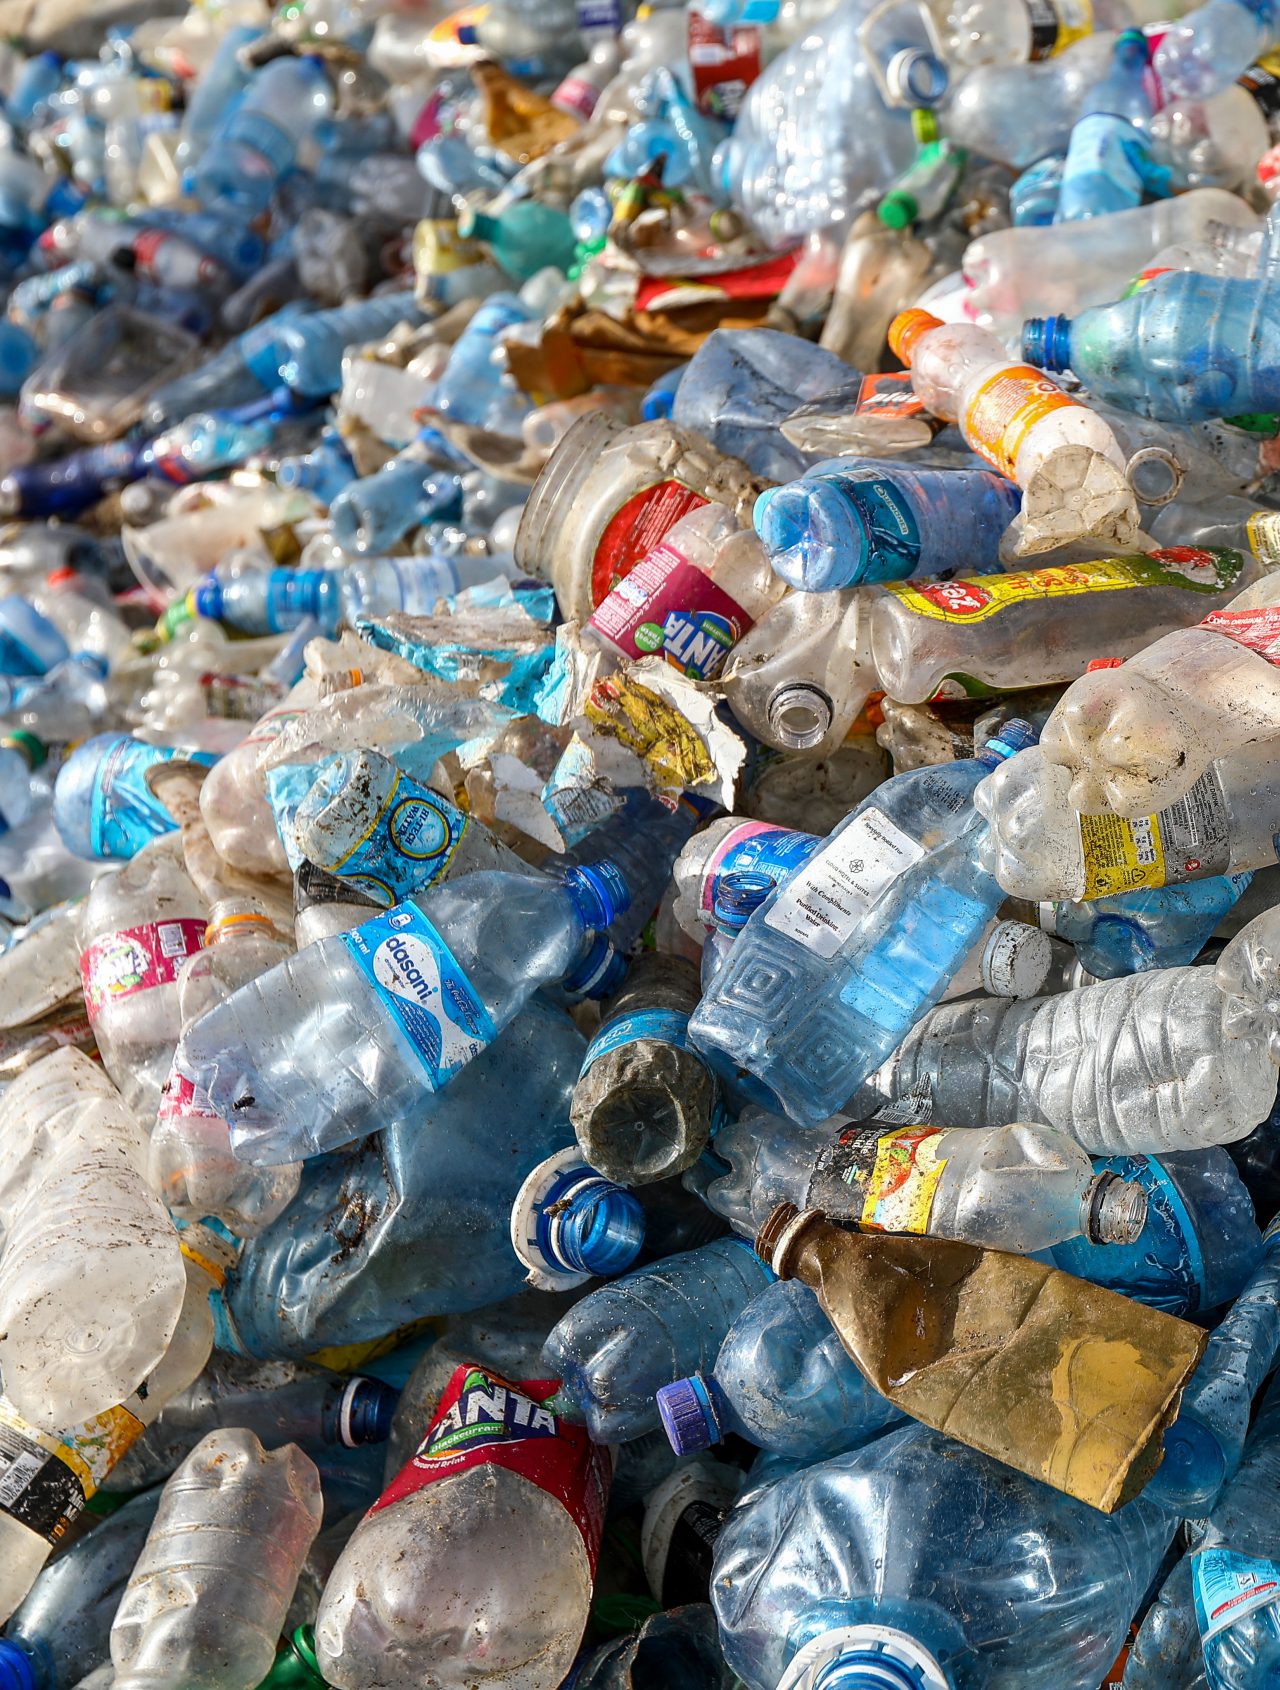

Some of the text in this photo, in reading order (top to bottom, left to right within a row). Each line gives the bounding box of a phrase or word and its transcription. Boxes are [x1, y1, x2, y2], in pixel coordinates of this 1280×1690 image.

[873, 485, 909, 535] QUENCHER
[634, 630, 657, 649] Great
[663, 612, 728, 676] ANTA
[1209, 788, 1218, 807] DRINK
[405, 808, 430, 845] HI-TECH
[825, 859, 838, 871] CLOUD
[837, 869, 851, 882] HOTEL
[854, 883, 869, 896] SUITES
[795, 898, 838, 931] Purified Drinking
[805, 880, 819, 893] With
[816, 889, 852, 916] Compliments
[804, 914, 821, 927] Water
[358, 942, 370, 955] ml
[386, 937, 439, 1001] dasani
[431, 1425, 504, 1453] Blackcurran
[440, 1455, 466, 1467] Drink
